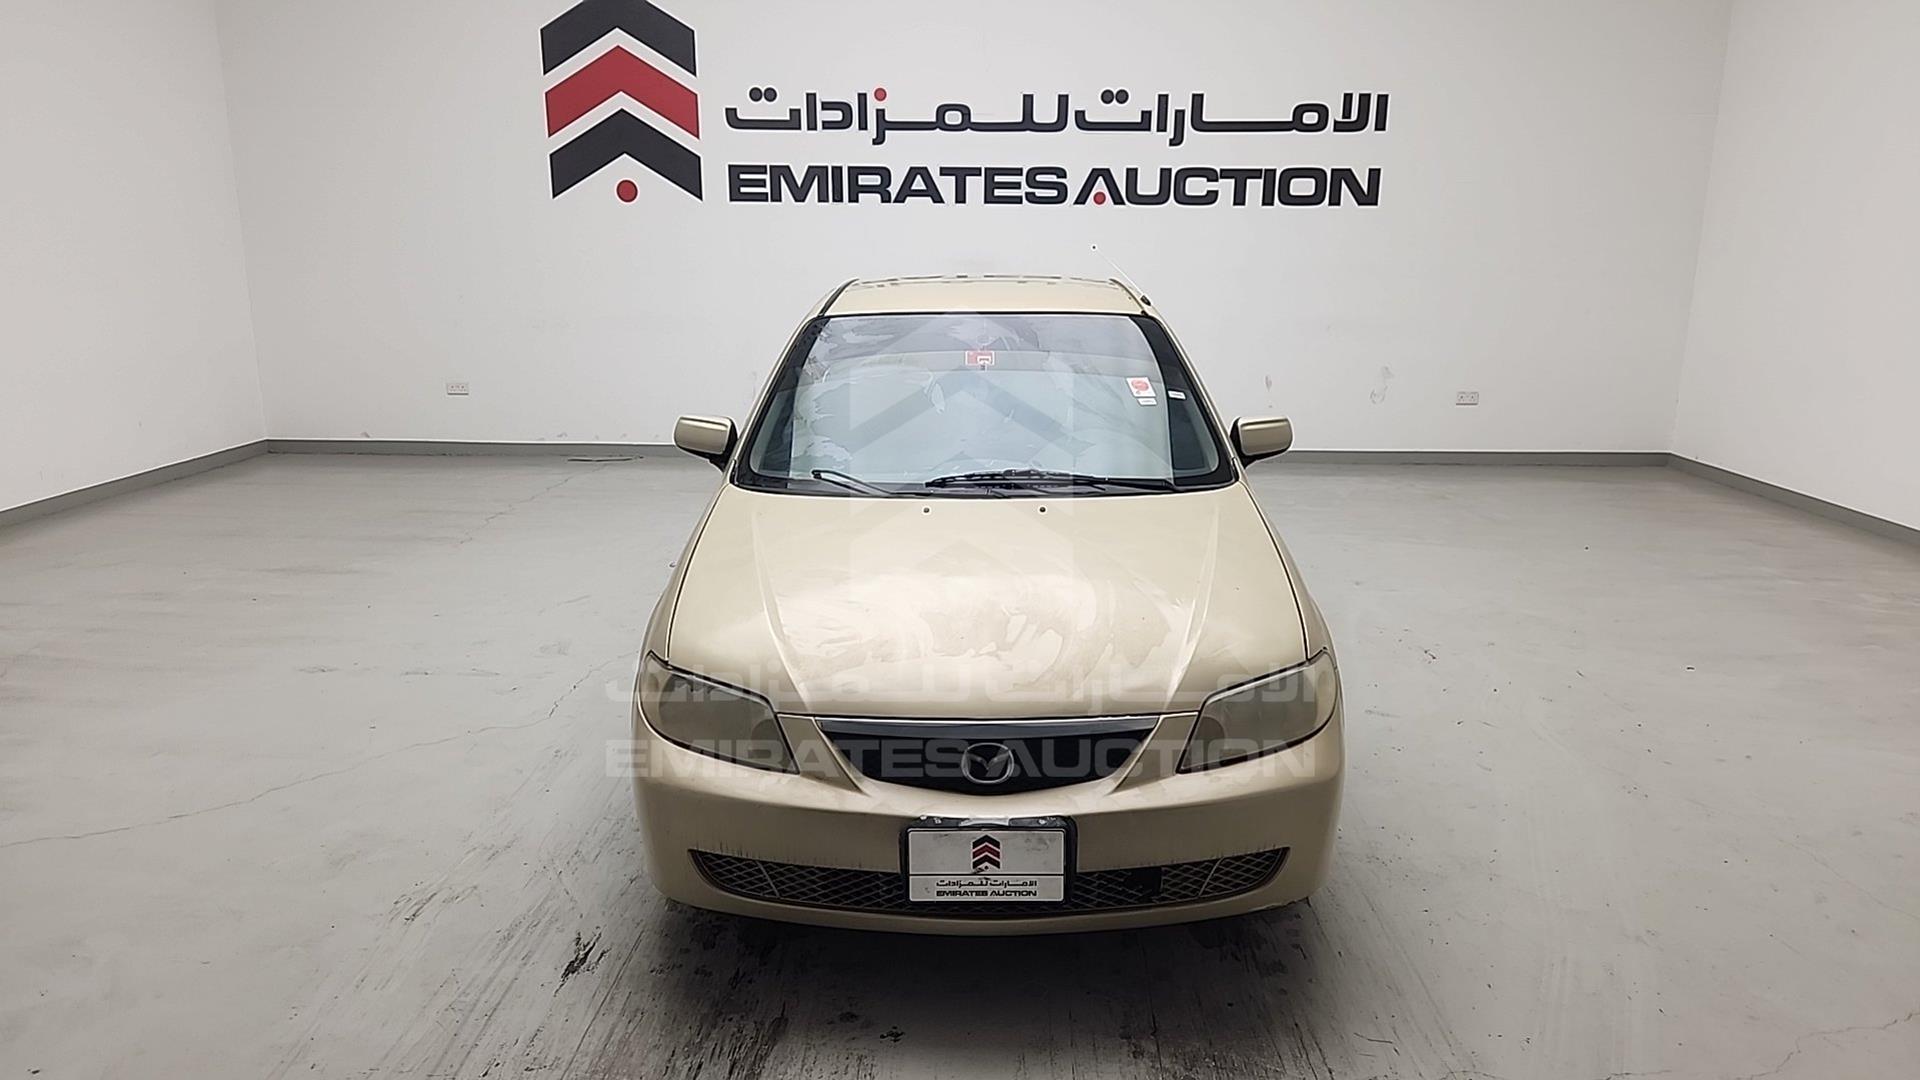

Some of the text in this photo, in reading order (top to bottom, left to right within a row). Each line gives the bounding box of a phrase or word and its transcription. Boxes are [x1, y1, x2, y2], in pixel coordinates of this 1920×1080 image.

[725, 87, 1389, 147] الامارات للمزادات
[728, 164, 1381, 206] EMIRATES AUCTION
